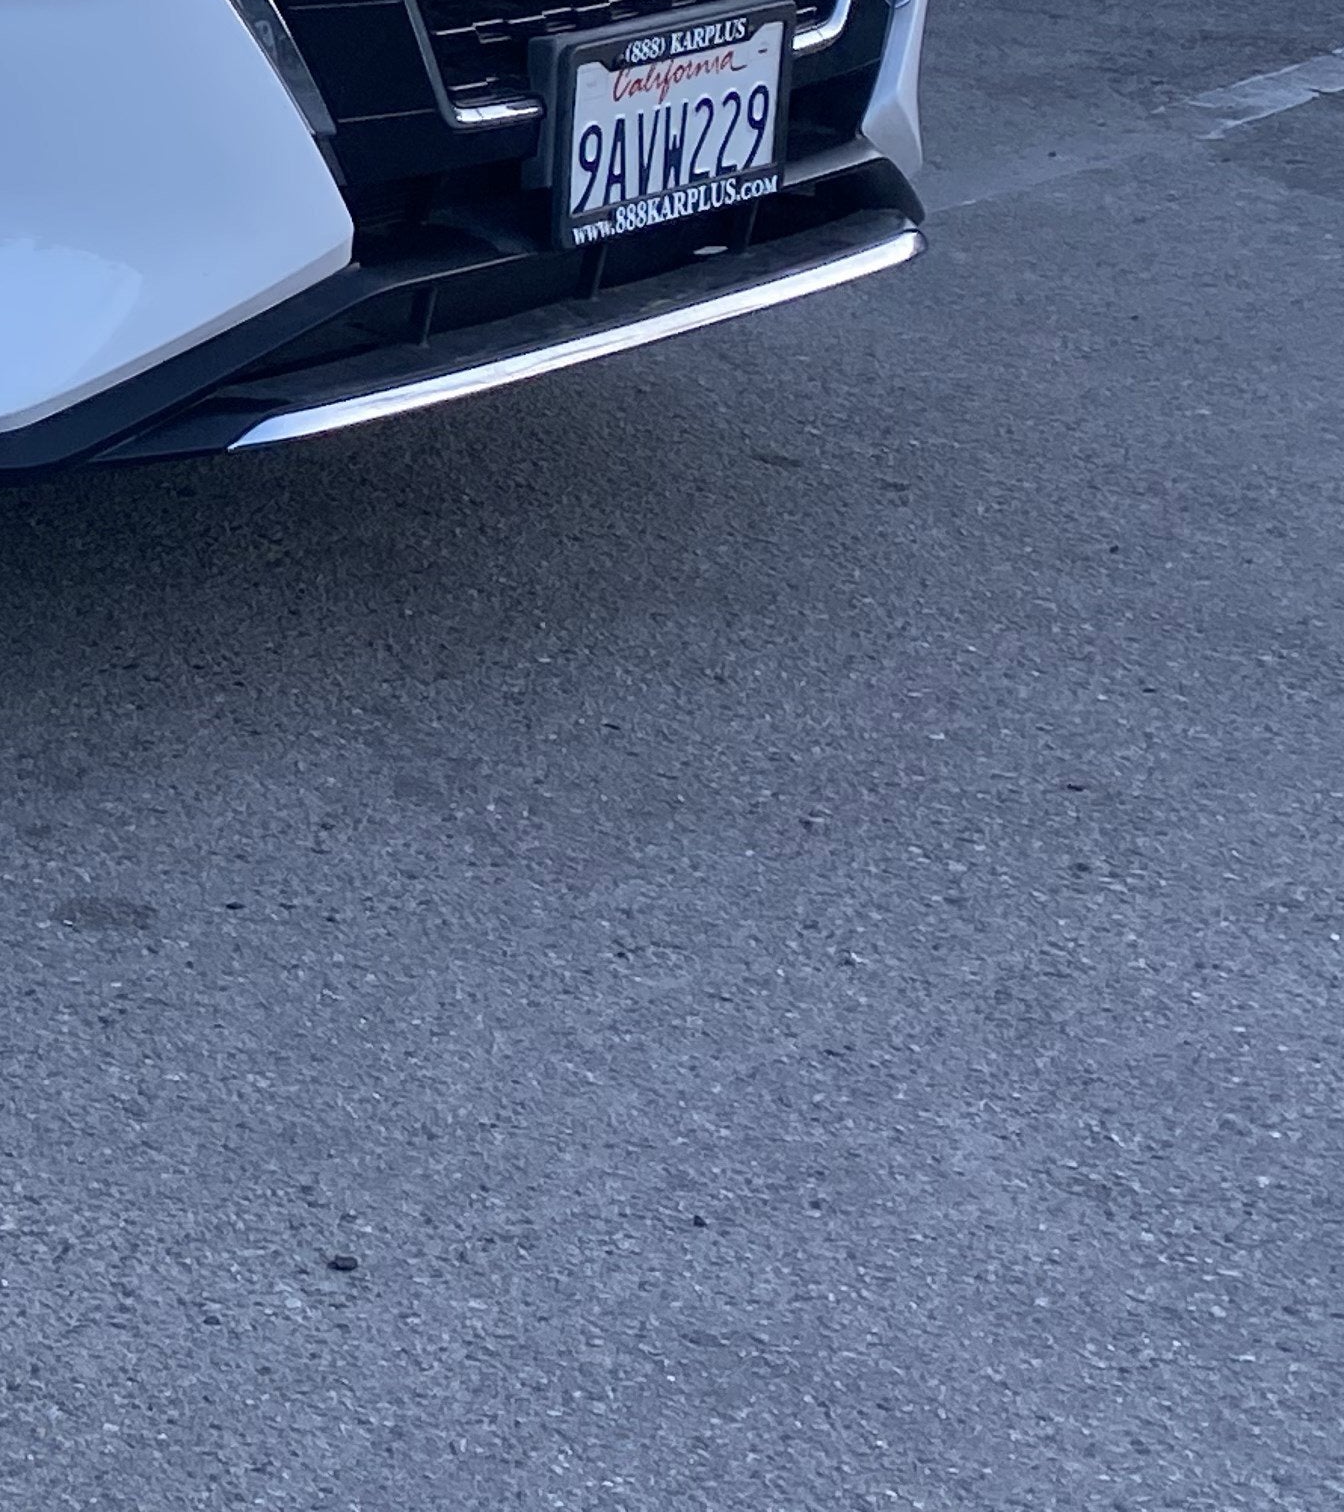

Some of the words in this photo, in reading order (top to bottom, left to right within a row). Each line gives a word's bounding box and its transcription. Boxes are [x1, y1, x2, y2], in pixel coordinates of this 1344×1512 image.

[625, 36, 665, 62] (888)
[670, 18, 746, 54] KARPLUS
[613, 50, 747, 104] California
[573, 84, 770, 214] 9AVW229
